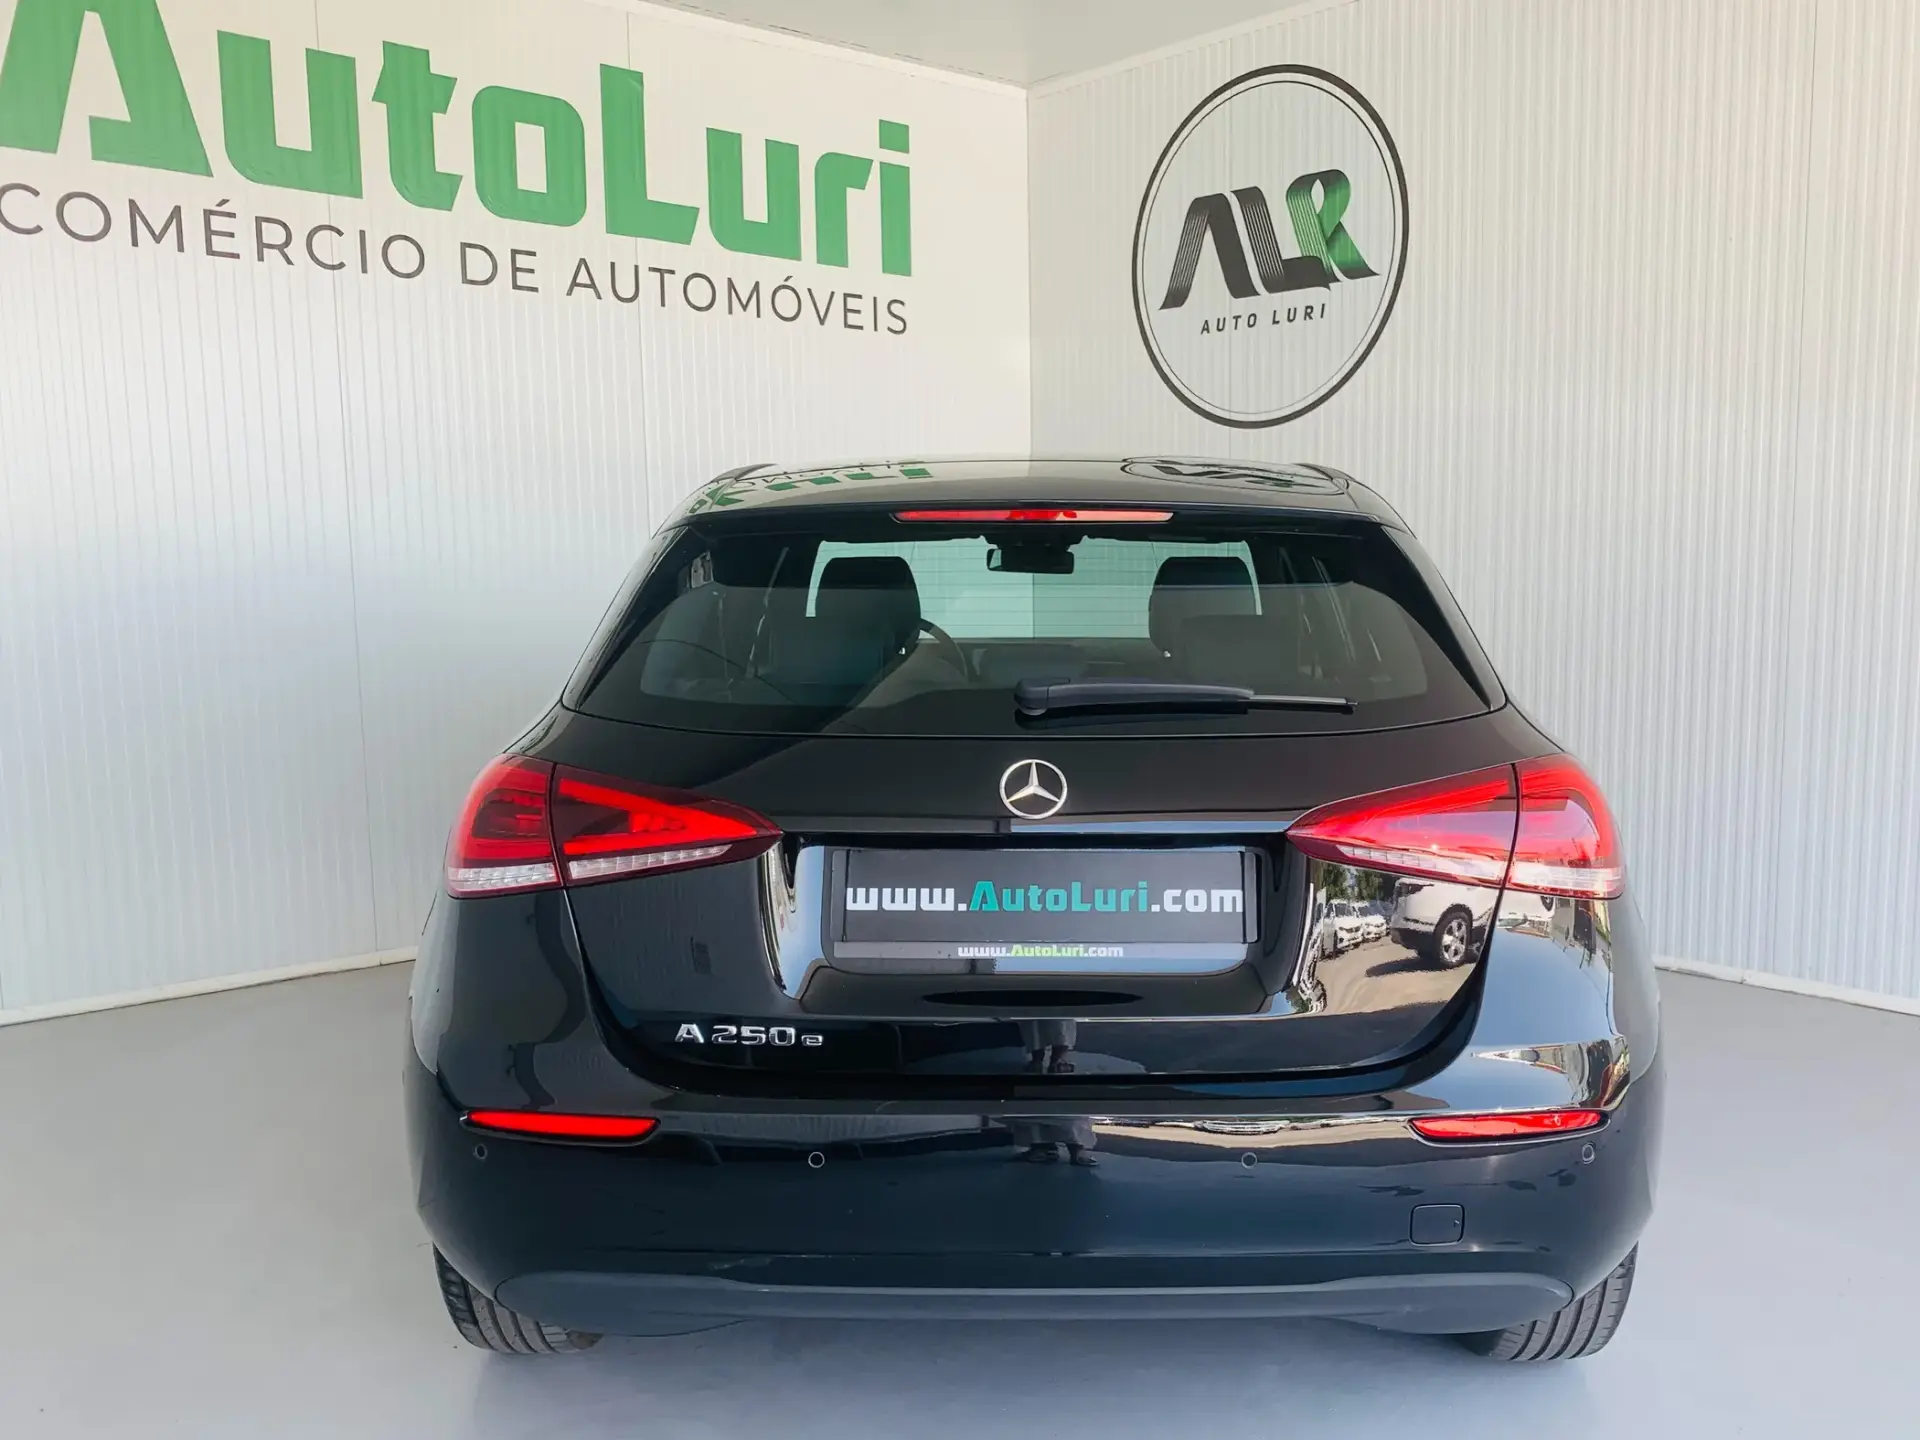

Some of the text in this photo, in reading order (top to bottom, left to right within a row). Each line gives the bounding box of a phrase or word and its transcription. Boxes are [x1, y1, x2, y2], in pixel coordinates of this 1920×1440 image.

[0, 0, 912, 277] AutoLuri
[0, 184, 908, 335] COMÉRCIO DE AUTOMÓVEIS
[1200, 303, 1326, 335] AUTO LURI
[846, 881, 1244, 913] www.AutoLuri.com
[957, 944, 1125, 958] www.AutoLuri.com
[675, 1023, 705, 1044] A
